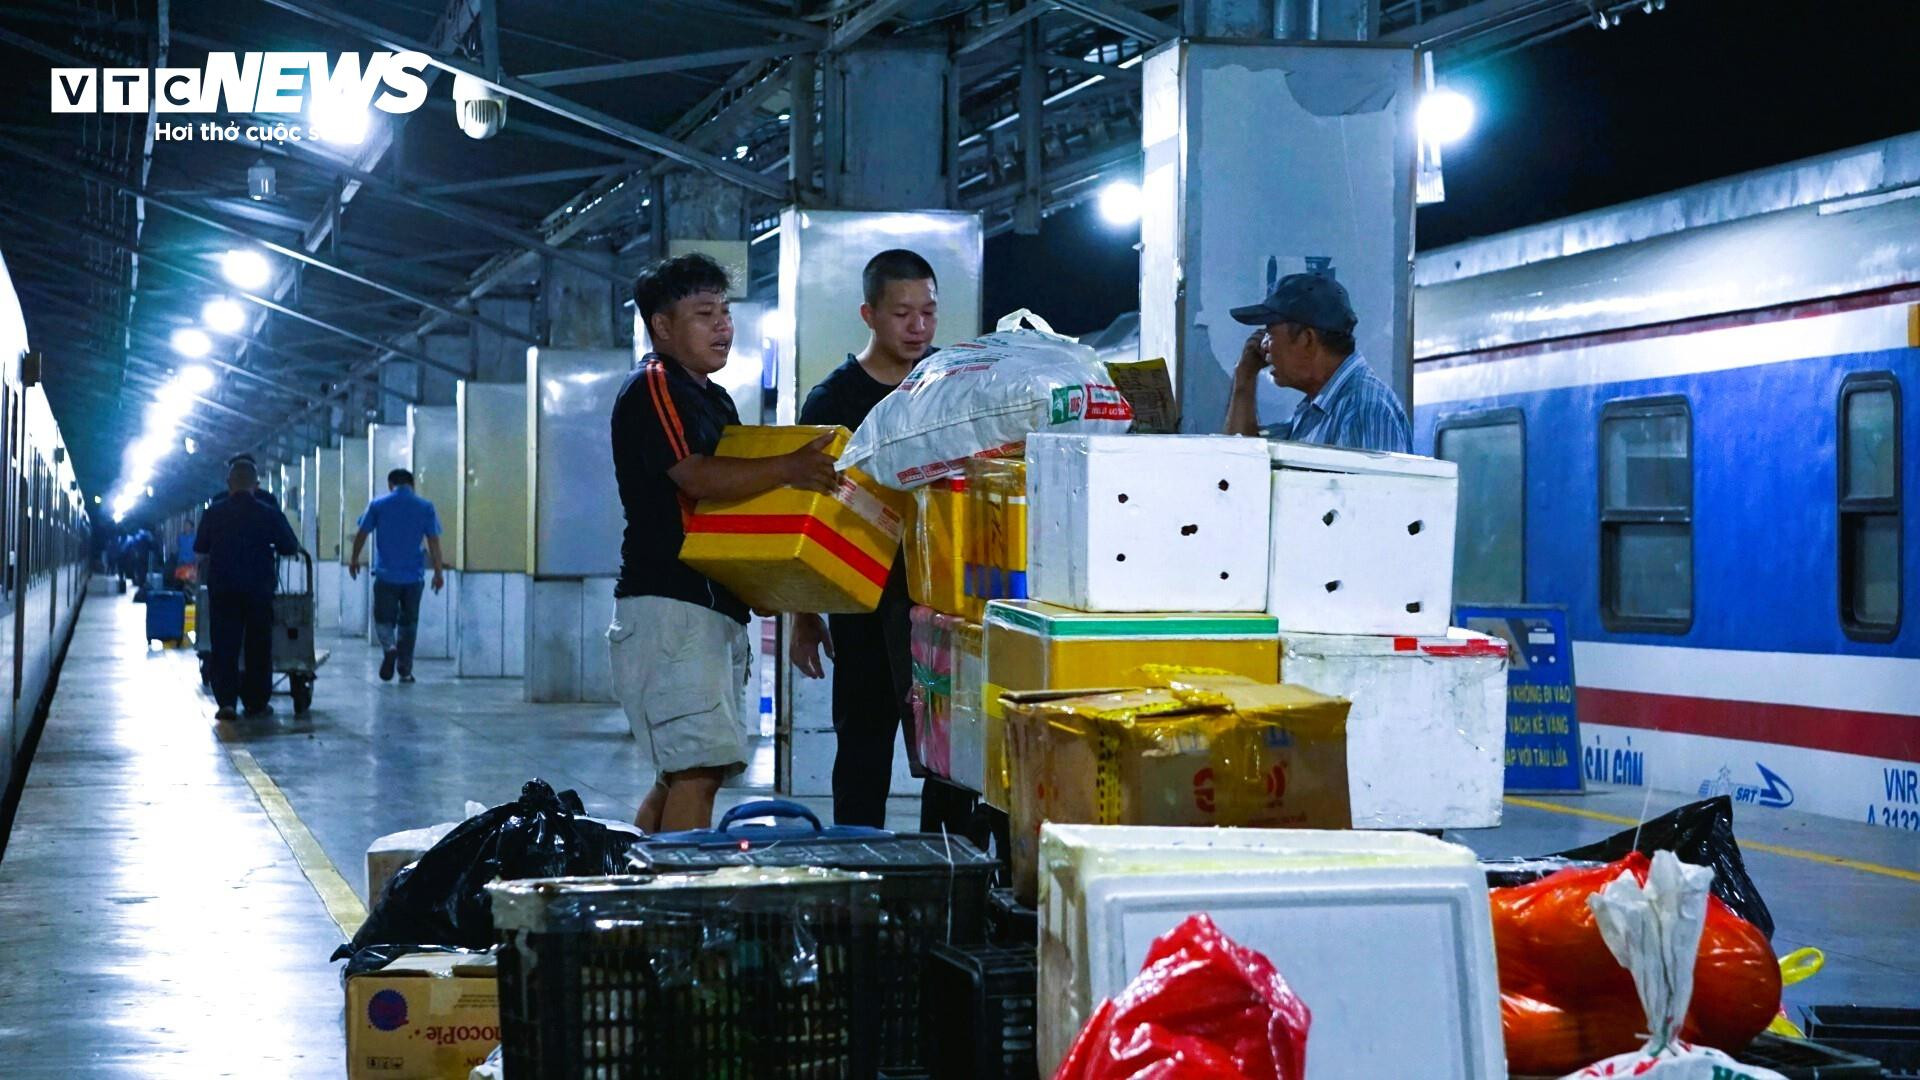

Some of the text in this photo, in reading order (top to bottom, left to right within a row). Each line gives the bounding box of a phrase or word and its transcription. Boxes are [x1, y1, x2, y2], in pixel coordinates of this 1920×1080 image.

[1735, 786, 1758, 803] SRT
[1883, 767, 1919, 805] VNR
[426, 1025, 502, 1046] ocoPie
